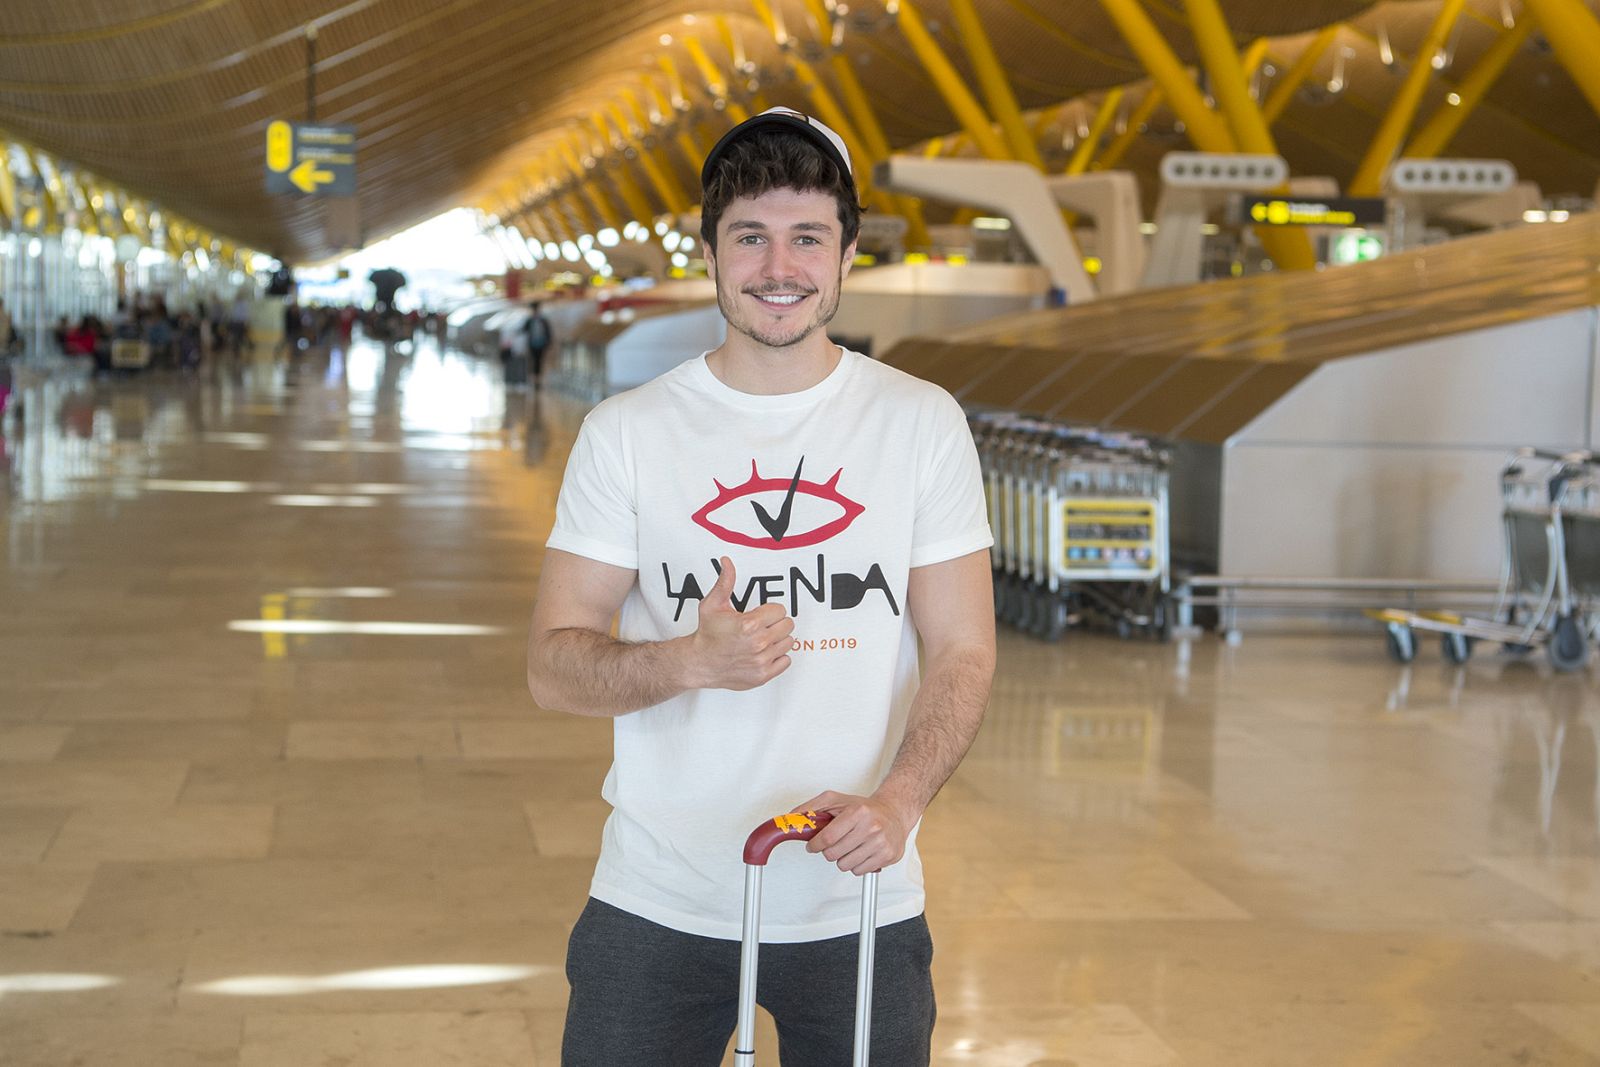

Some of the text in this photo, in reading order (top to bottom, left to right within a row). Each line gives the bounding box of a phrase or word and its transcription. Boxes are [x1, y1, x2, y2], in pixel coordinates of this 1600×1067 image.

[662, 554, 900, 622] LA VENDA
[820, 638, 857, 650] 2019
